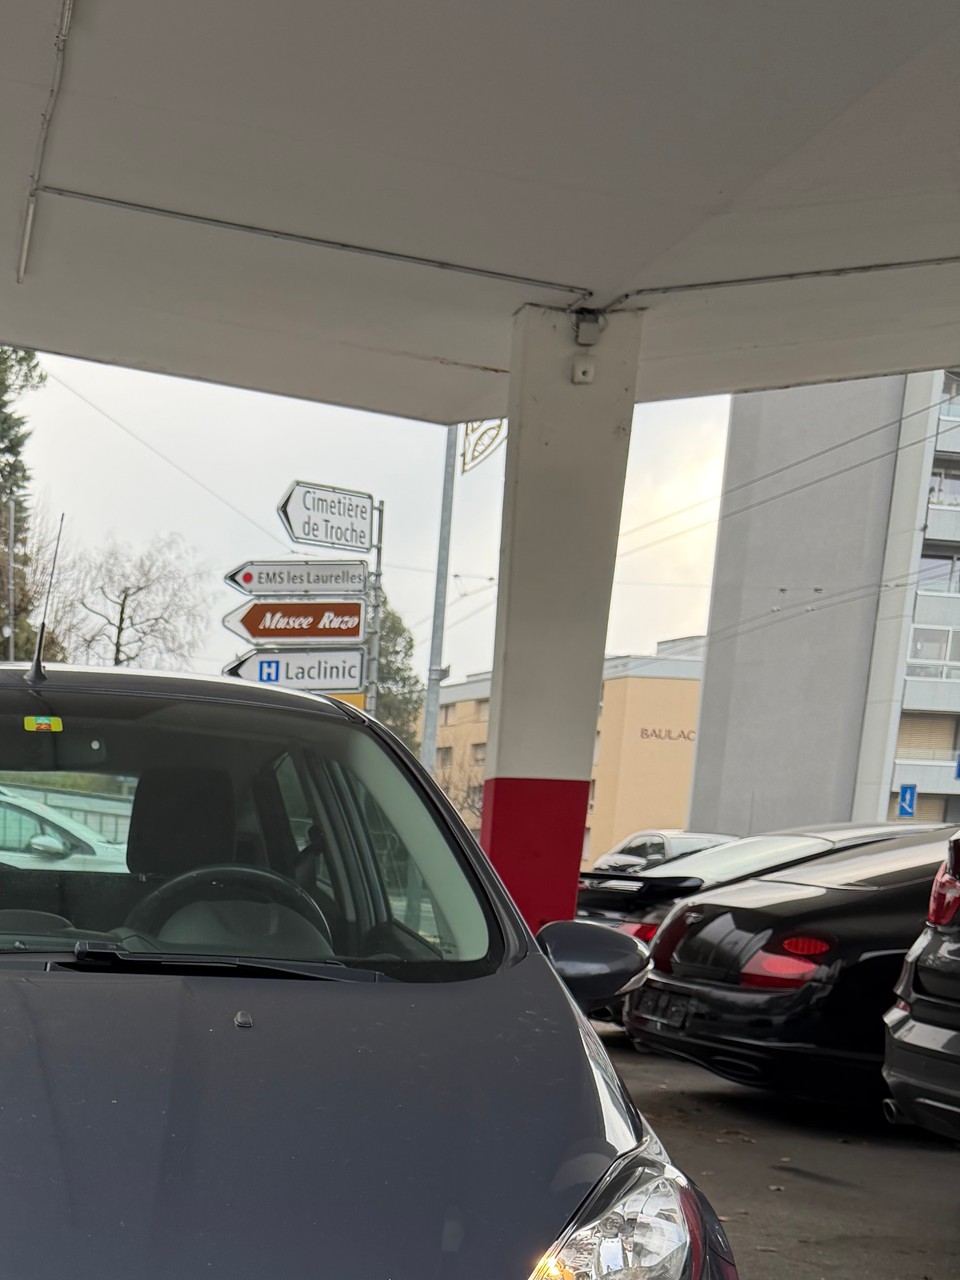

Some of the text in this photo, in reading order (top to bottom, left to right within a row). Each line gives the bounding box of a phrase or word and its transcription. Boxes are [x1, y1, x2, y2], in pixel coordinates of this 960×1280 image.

[302, 490, 367, 520] Cimetière
[302, 515, 366, 545] de Troche
[257, 570, 363, 585] EMS les Laurelles
[261, 660, 358, 681] H Laclinic
[640, 728, 697, 741] BAULAC
